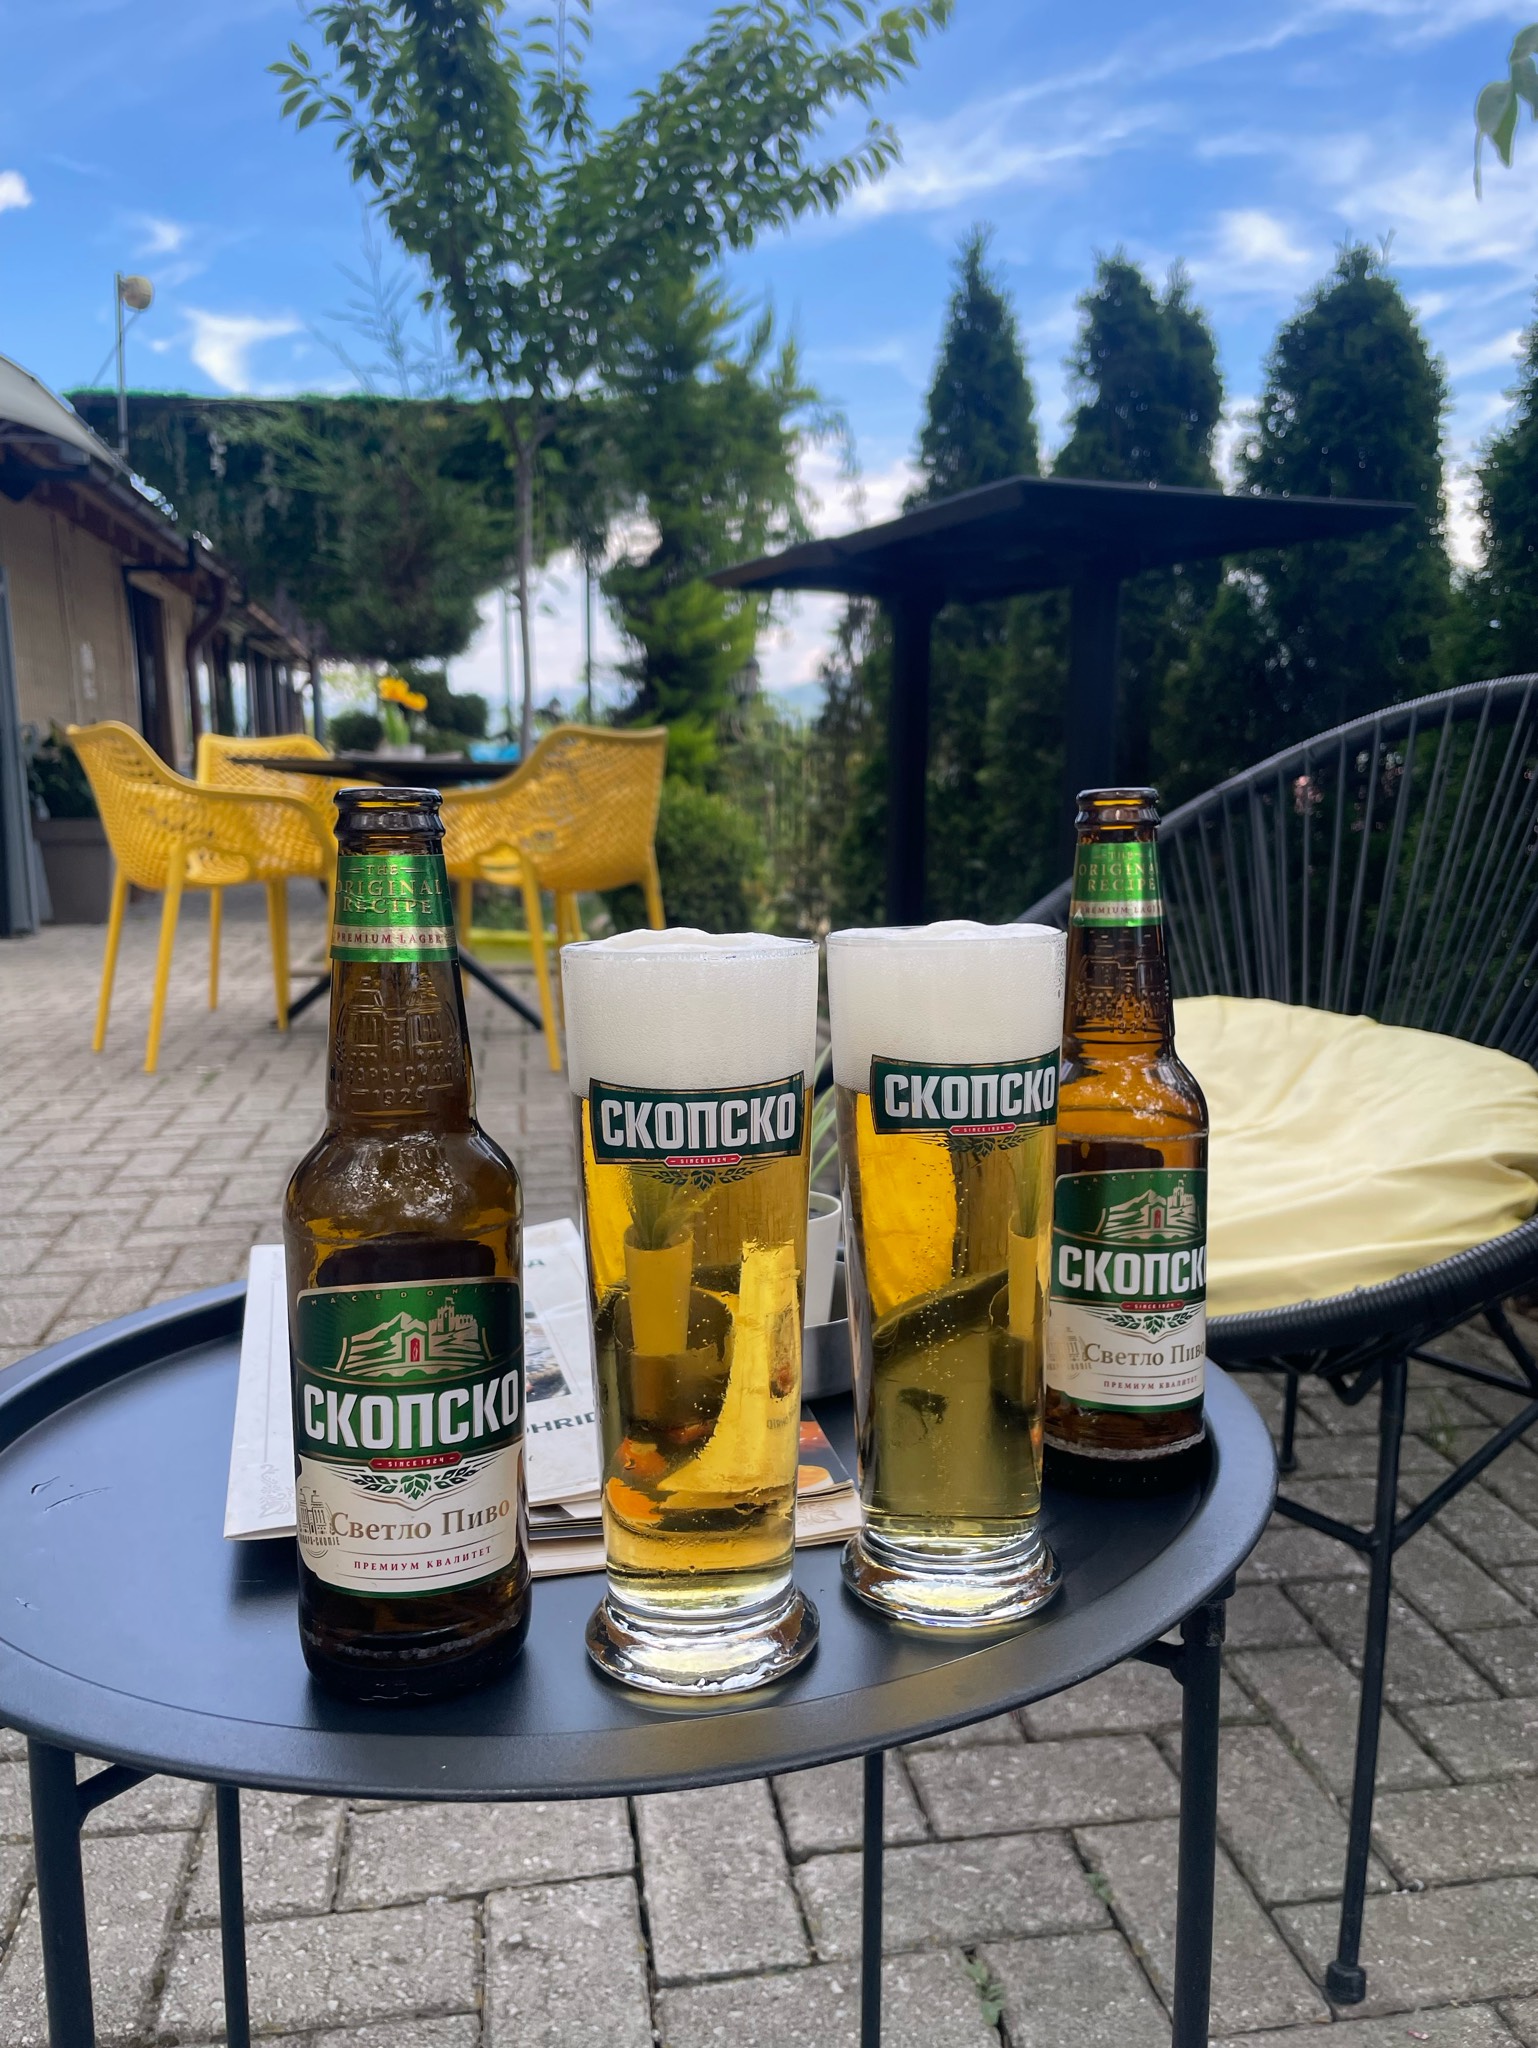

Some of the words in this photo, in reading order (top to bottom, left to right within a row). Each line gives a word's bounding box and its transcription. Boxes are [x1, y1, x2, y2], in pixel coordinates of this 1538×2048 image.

[366, 864, 399, 876] THE
[1087, 878, 1156, 892] RECIPE
[342, 895, 432, 914] RECIPE
[336, 931, 392, 944] PREMIUM
[399, 932, 443, 944] LAGER
[884, 1066, 1056, 1120] СКОПСКО
[600, 1092, 796, 1150] СКОПСКО
[1058, 1244, 1206, 1296] СКОПСК
[1084, 1343, 1164, 1366] Светло
[1103, 1380, 1155, 1390] ПРЕМИУМ
[1159, 1375, 1198, 1389] КВАЛИТЕТ
[303, 1369, 519, 1449] СКОПСКО
[421, 1457, 444, 1466] 1924
[332, 1512, 432, 1540] Светло
[441, 1499, 510, 1536] Пиво
[354, 1560, 420, 1572] ПРЕМИУМ
[426, 1545, 492, 1569] КВАЛИТЕТ
